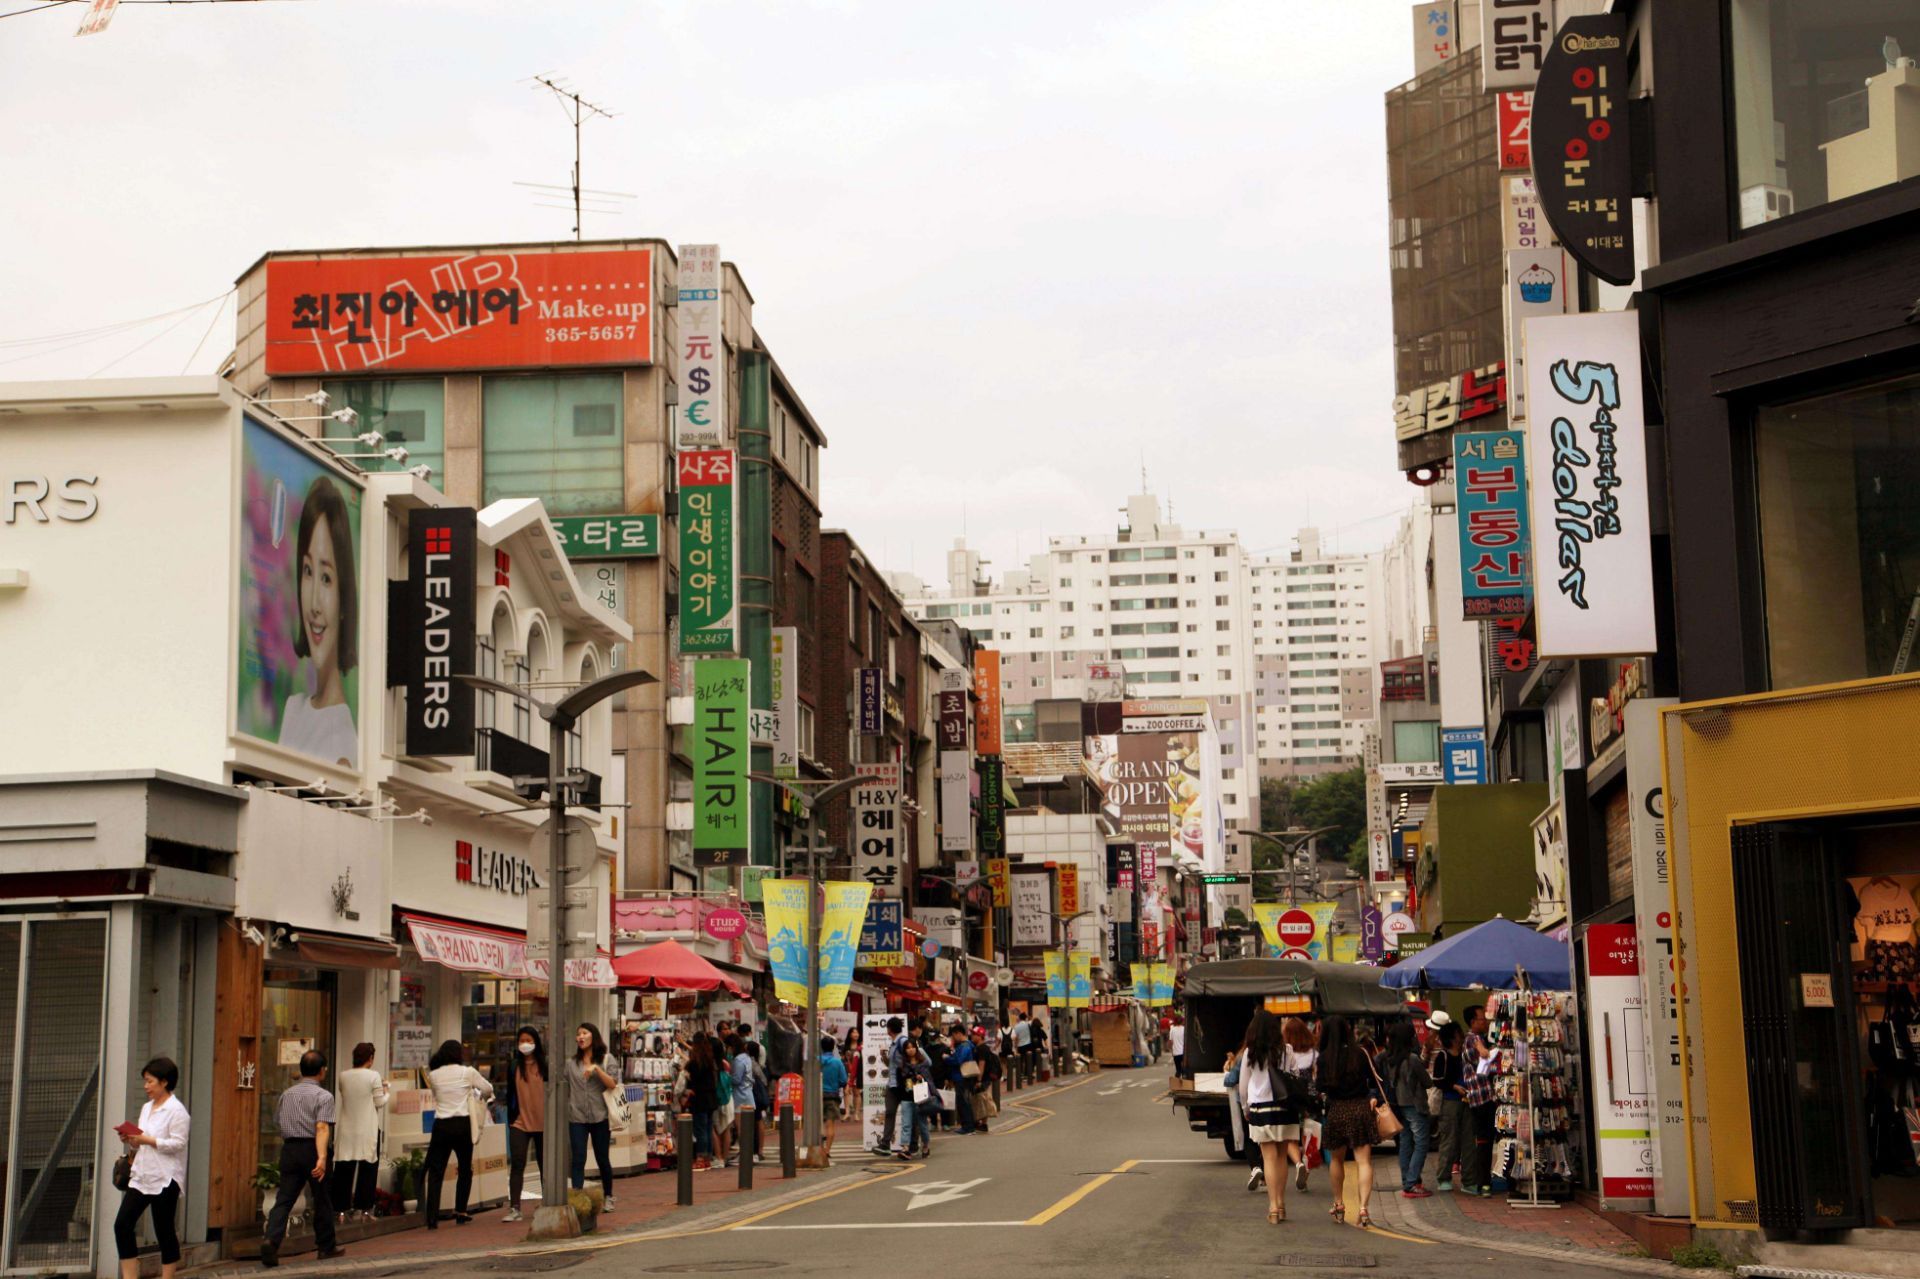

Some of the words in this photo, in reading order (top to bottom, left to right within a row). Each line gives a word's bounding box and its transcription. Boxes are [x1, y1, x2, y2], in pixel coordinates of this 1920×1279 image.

[1583, 37, 1597, 49] hair
[1599, 36, 1619, 48] salon
[292, 293, 418, 343] 최진아
[431, 288, 519, 326] 헤어
[311, 253, 532, 372] HAIR
[545, 325, 637, 343] 365-5657
[685, 336, 713, 360] 元
[688, 367, 712, 394] $
[1550, 359, 1621, 410] 5
[684, 400, 711, 426] €
[1460, 437, 1520, 460] 서울
[1591, 407, 1622, 488] 아버지가
[681, 455, 730, 482] 사주
[4, 474, 99, 524] RS
[1550, 417, 1594, 610] dollar
[1593, 492, 1622, 538] 주신
[1464, 466, 1524, 589] 부동산
[687, 493, 717, 617] 인생이야기
[423, 553, 451, 730] LEADERS
[683, 633, 729, 645] 362-8457
[942, 695, 965, 743] 초밥
[1147, 720, 1163, 730] ZOO
[1164, 719, 1194, 729] COFFEE
[705, 707, 736, 808] HAIR
[780, 752, 793, 764] 2F
[1109, 760, 1180, 779] GRAND
[858, 789, 897, 805] H&Y
[1107, 781, 1179, 805] OPEN
[706, 813, 737, 829] 헤어
[714, 851, 729, 862] 2F
[710, 918, 740, 927] ETUDE
[1364, 910, 1376, 947] VDL
[437, 934, 480, 964] GRAND
[481, 941, 504, 970] OPEN
[860, 931, 899, 950] 복사
